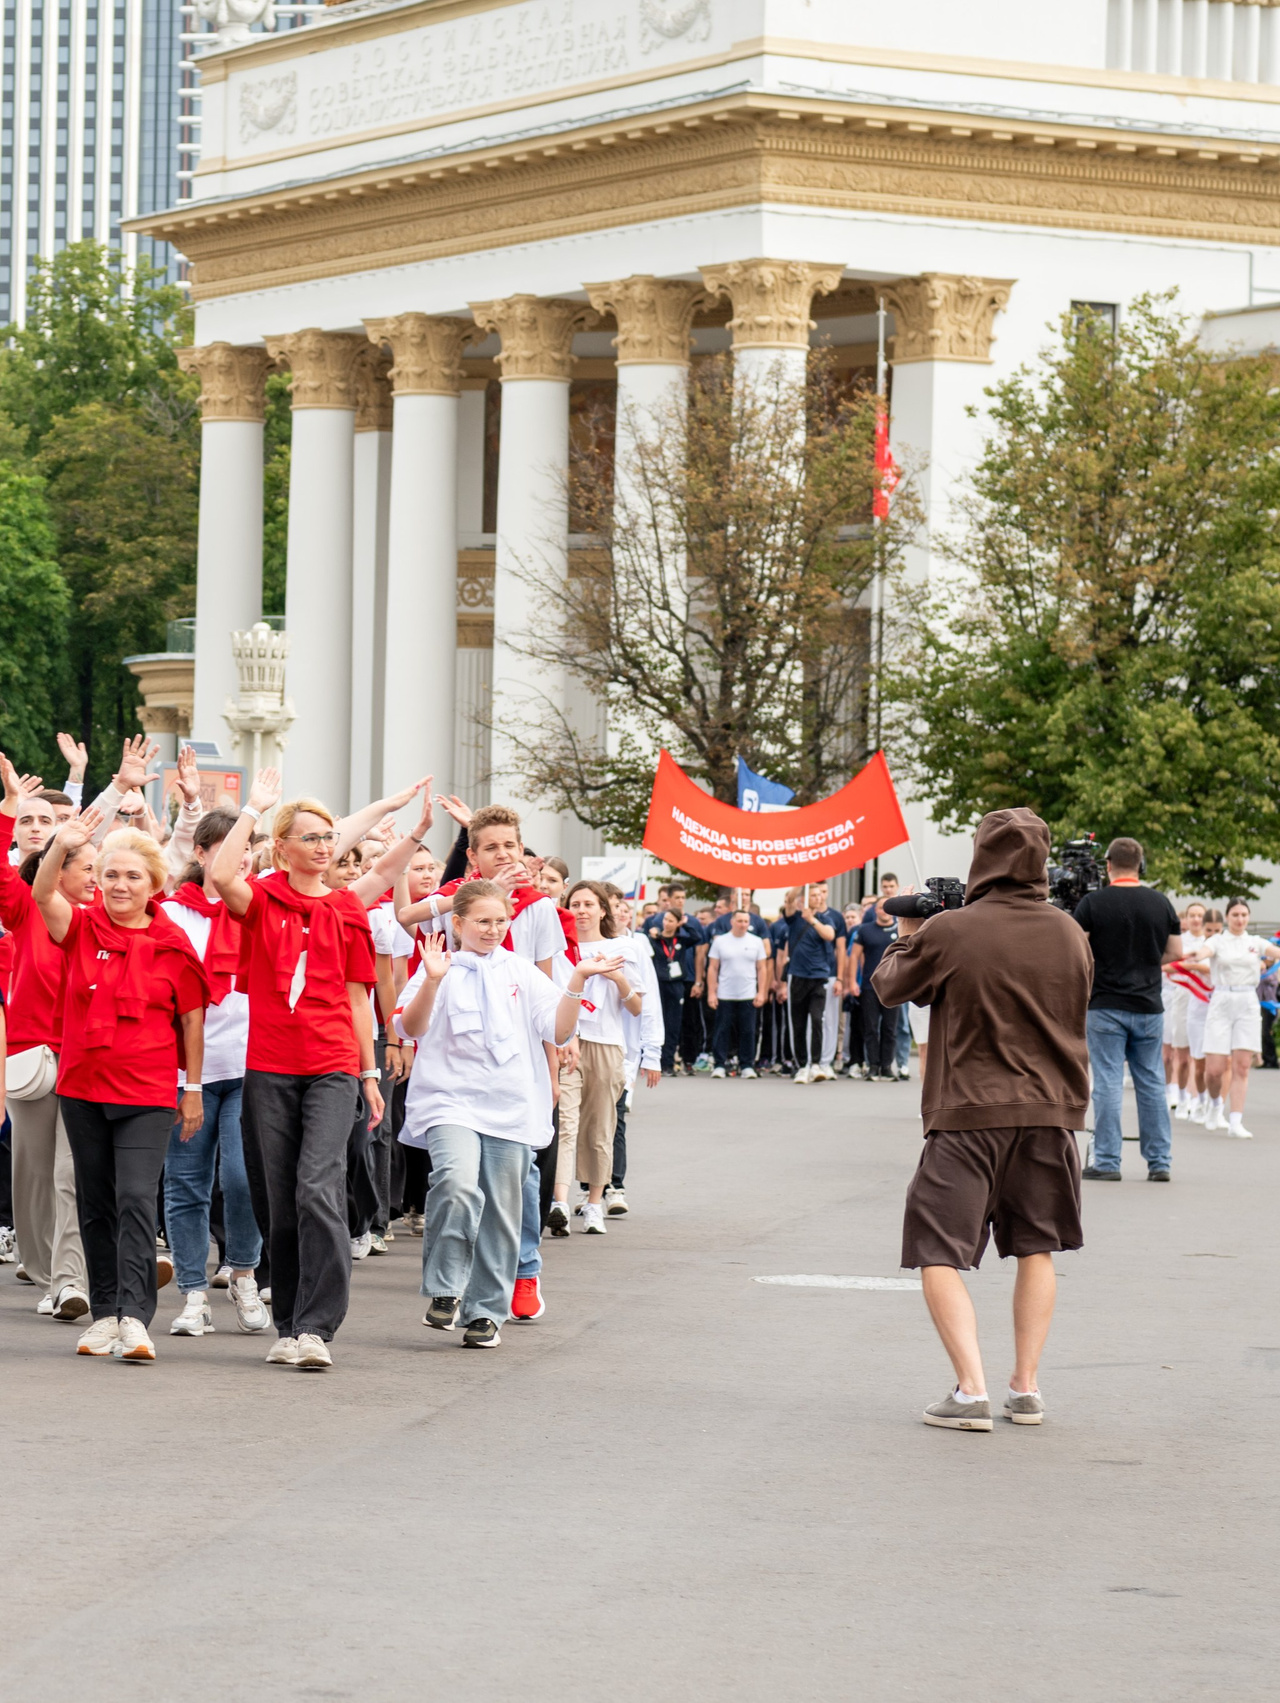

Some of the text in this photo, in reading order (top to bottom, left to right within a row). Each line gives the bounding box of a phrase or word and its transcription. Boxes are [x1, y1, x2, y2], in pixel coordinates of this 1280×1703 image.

[309, 15, 628, 110] СОВЕТСКАЯ ФЕДЕРАТИВНАЯ
[351, 1, 573, 75] РОССИЙСКАЯ
[503, 43, 630, 95] РЕСПУБЛИКА
[671, 805, 730, 847] НАДЕЖДА
[731, 819, 855, 853] ЧЕЛОВЕЧЕСТВА
[679, 830, 855, 866] ЗДОРОВОЕ ОТЕЧЕСТВО!
